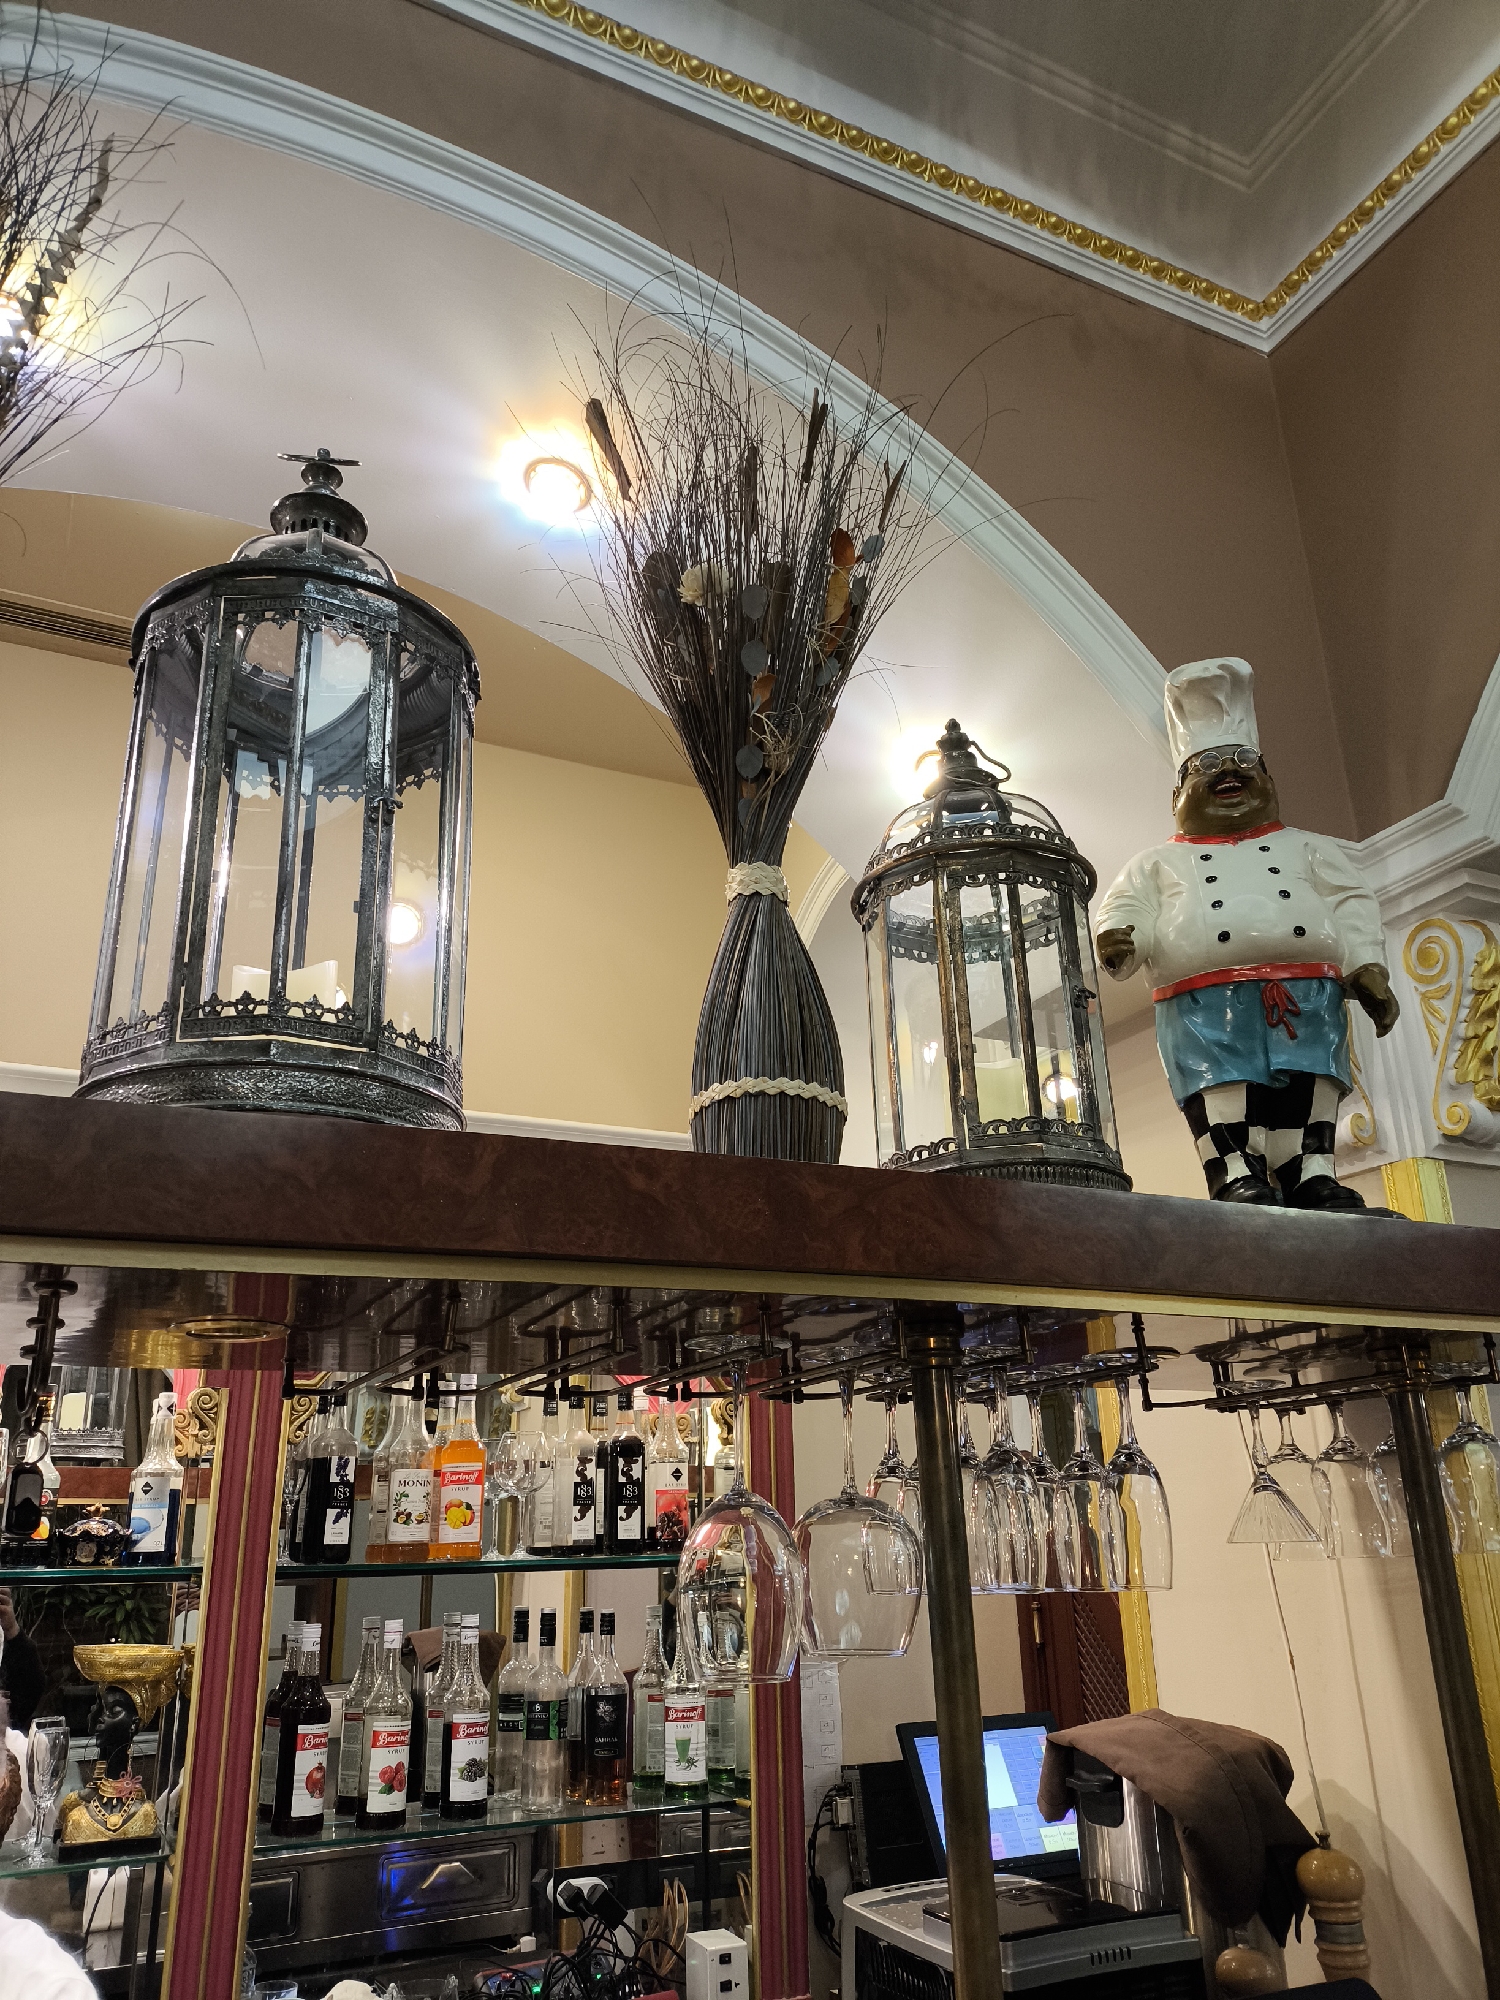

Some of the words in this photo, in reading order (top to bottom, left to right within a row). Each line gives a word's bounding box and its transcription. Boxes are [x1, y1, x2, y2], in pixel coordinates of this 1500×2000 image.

[398, 1480, 431, 1488] MONIN
[444, 1471, 479, 1485] Barinoff
[667, 1706, 703, 1720] Barinoff
